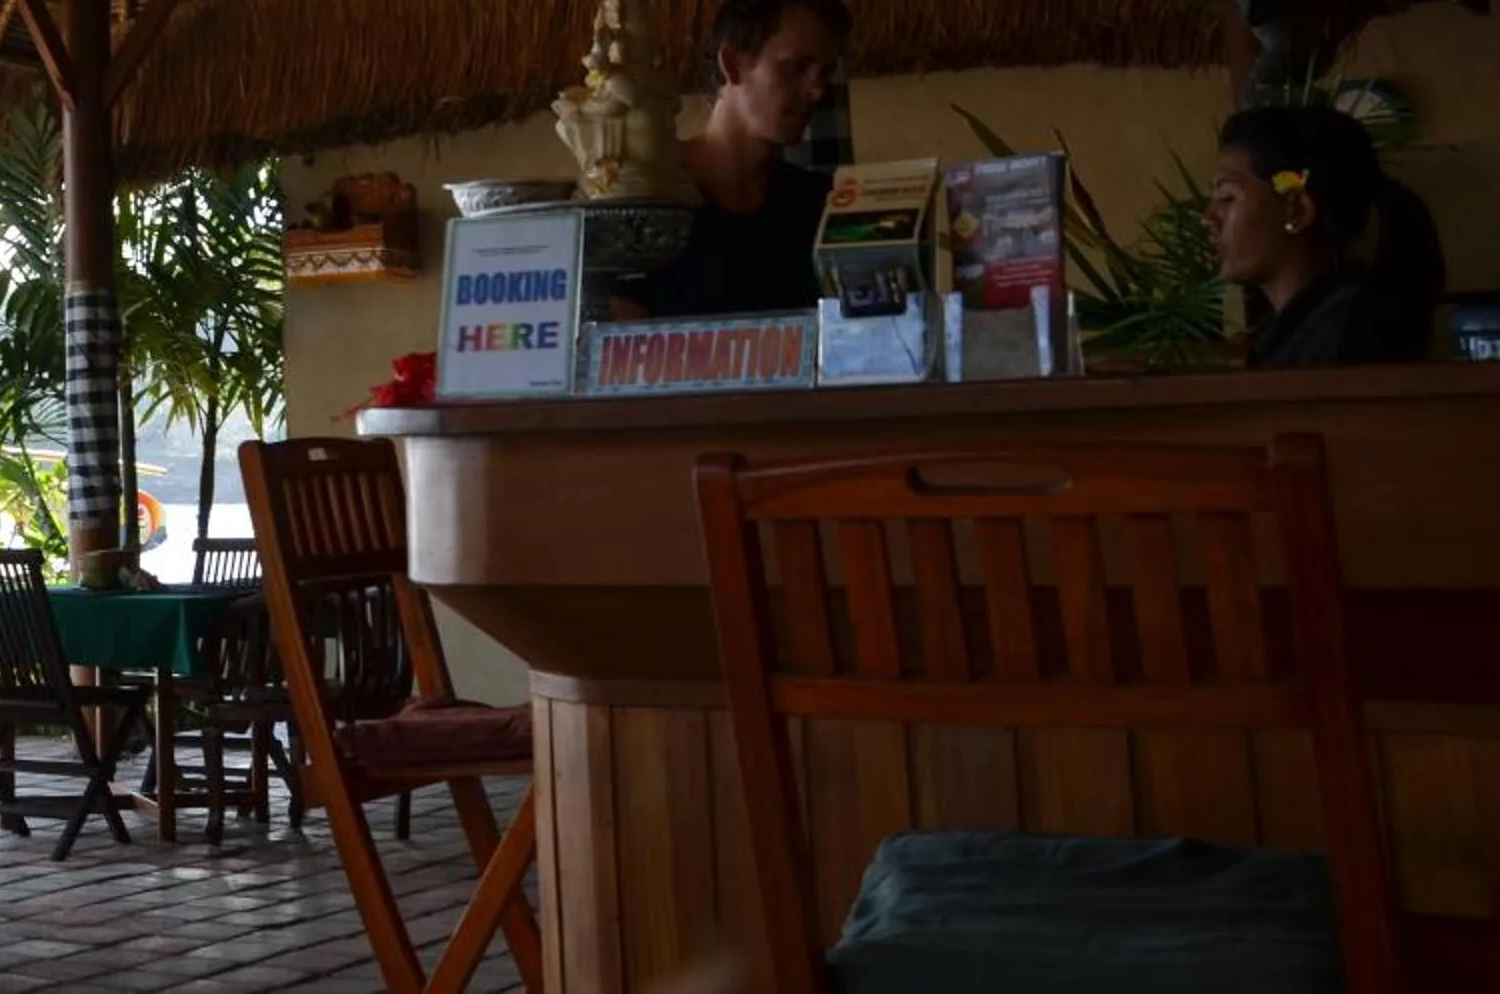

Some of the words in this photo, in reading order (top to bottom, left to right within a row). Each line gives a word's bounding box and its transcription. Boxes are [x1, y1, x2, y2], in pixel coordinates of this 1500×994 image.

[456, 269, 567, 305] BOOKING
[457, 321, 560, 353] HERE
[598, 325, 804, 384] INFORMATION
